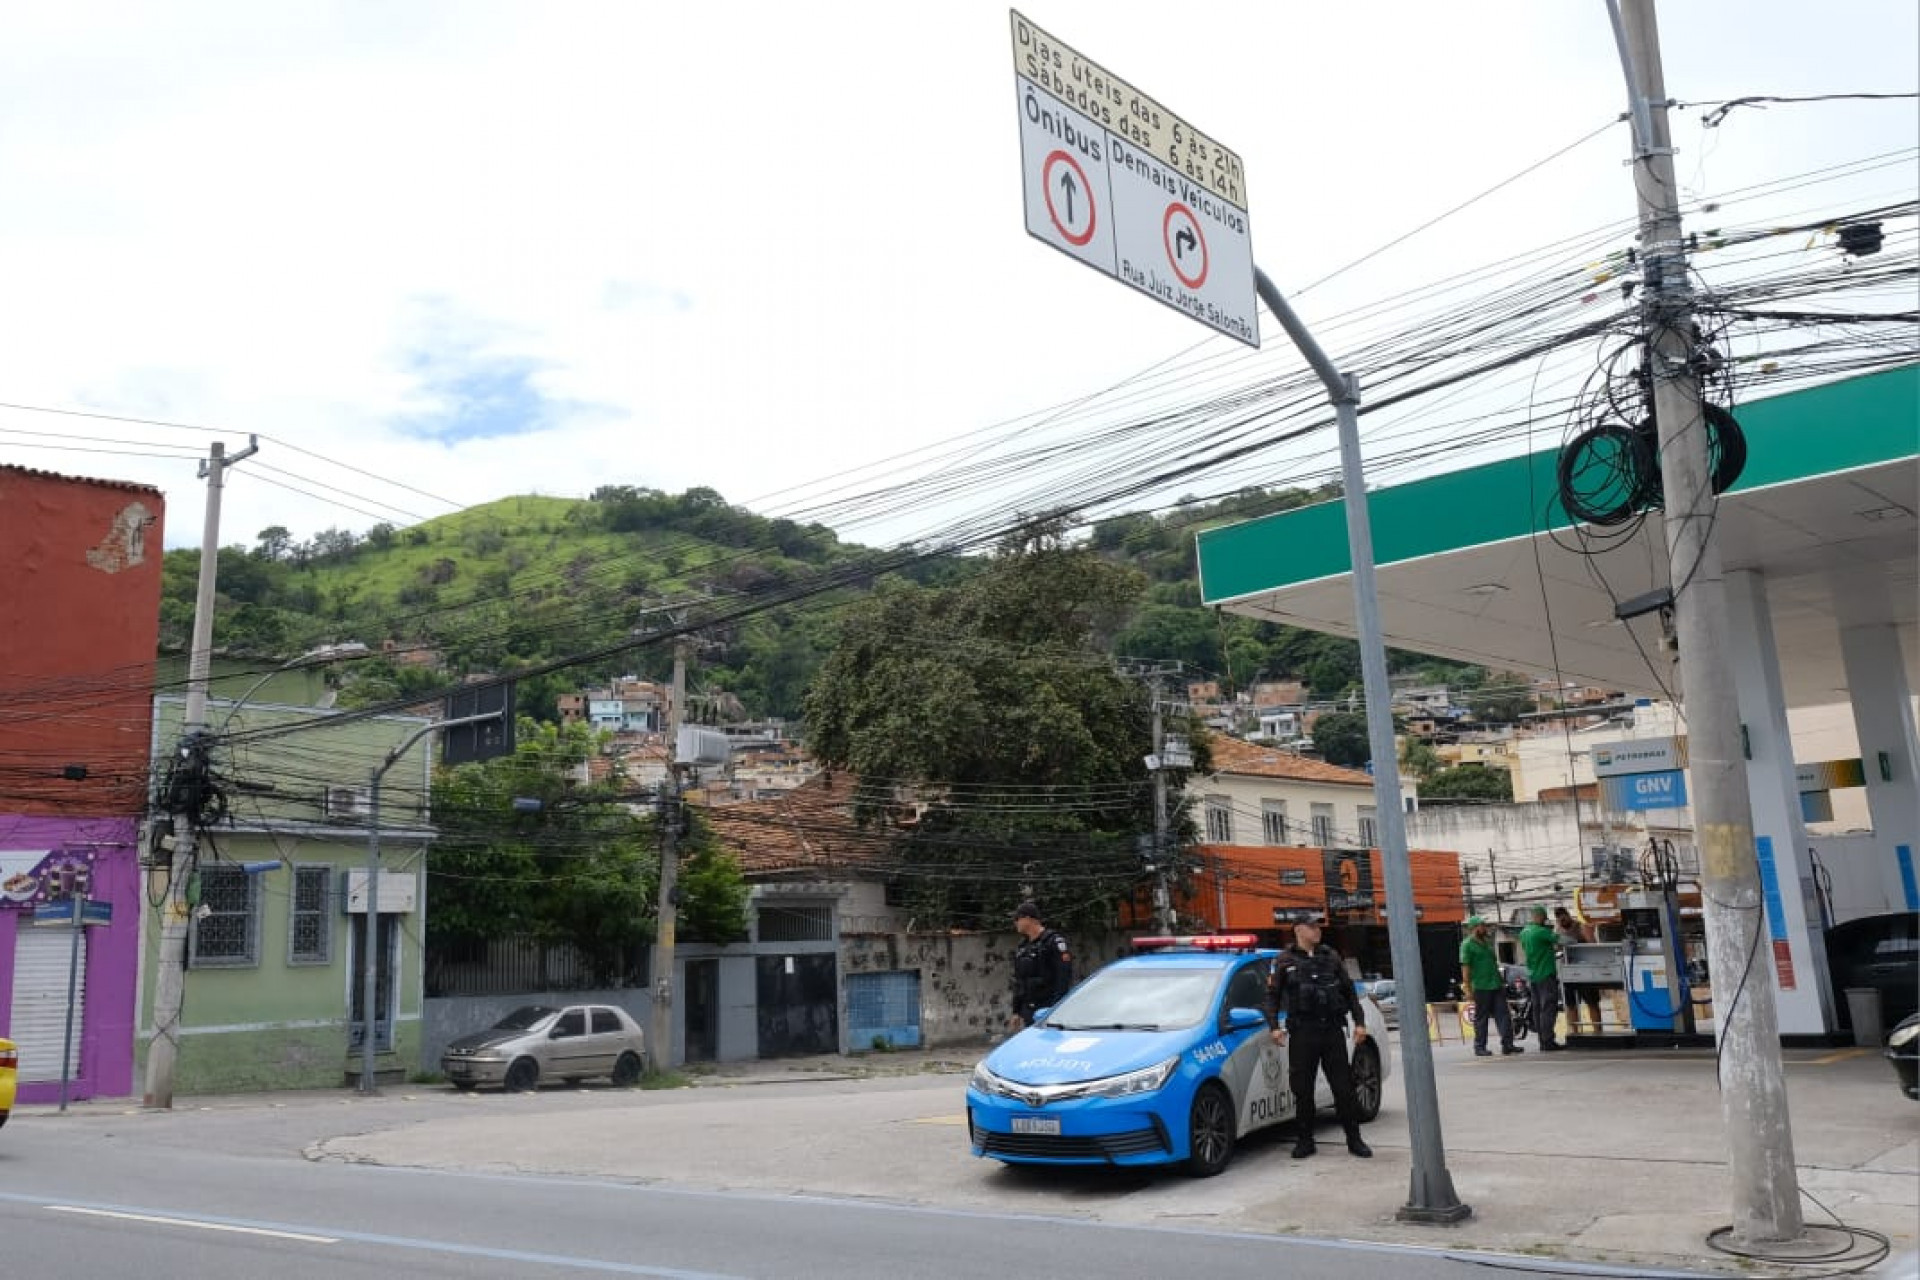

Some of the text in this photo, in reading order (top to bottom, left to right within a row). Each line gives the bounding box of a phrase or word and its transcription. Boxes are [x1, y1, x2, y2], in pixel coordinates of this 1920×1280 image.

[1017, 20, 1239, 180] Dias úteis das 6 às 21h
[1025, 86, 1100, 161] Ônibus
[1027, 53, 1111, 124] Sábados
[1119, 114, 1151, 148] das
[1169, 144, 1178, 166] 6
[1210, 169, 1238, 200] 14h
[1112, 139, 1176, 195] Demais
[1122, 259, 1252, 339] Rua Juiz Jorge Salomão
[1636, 776, 1672, 794] GNV
